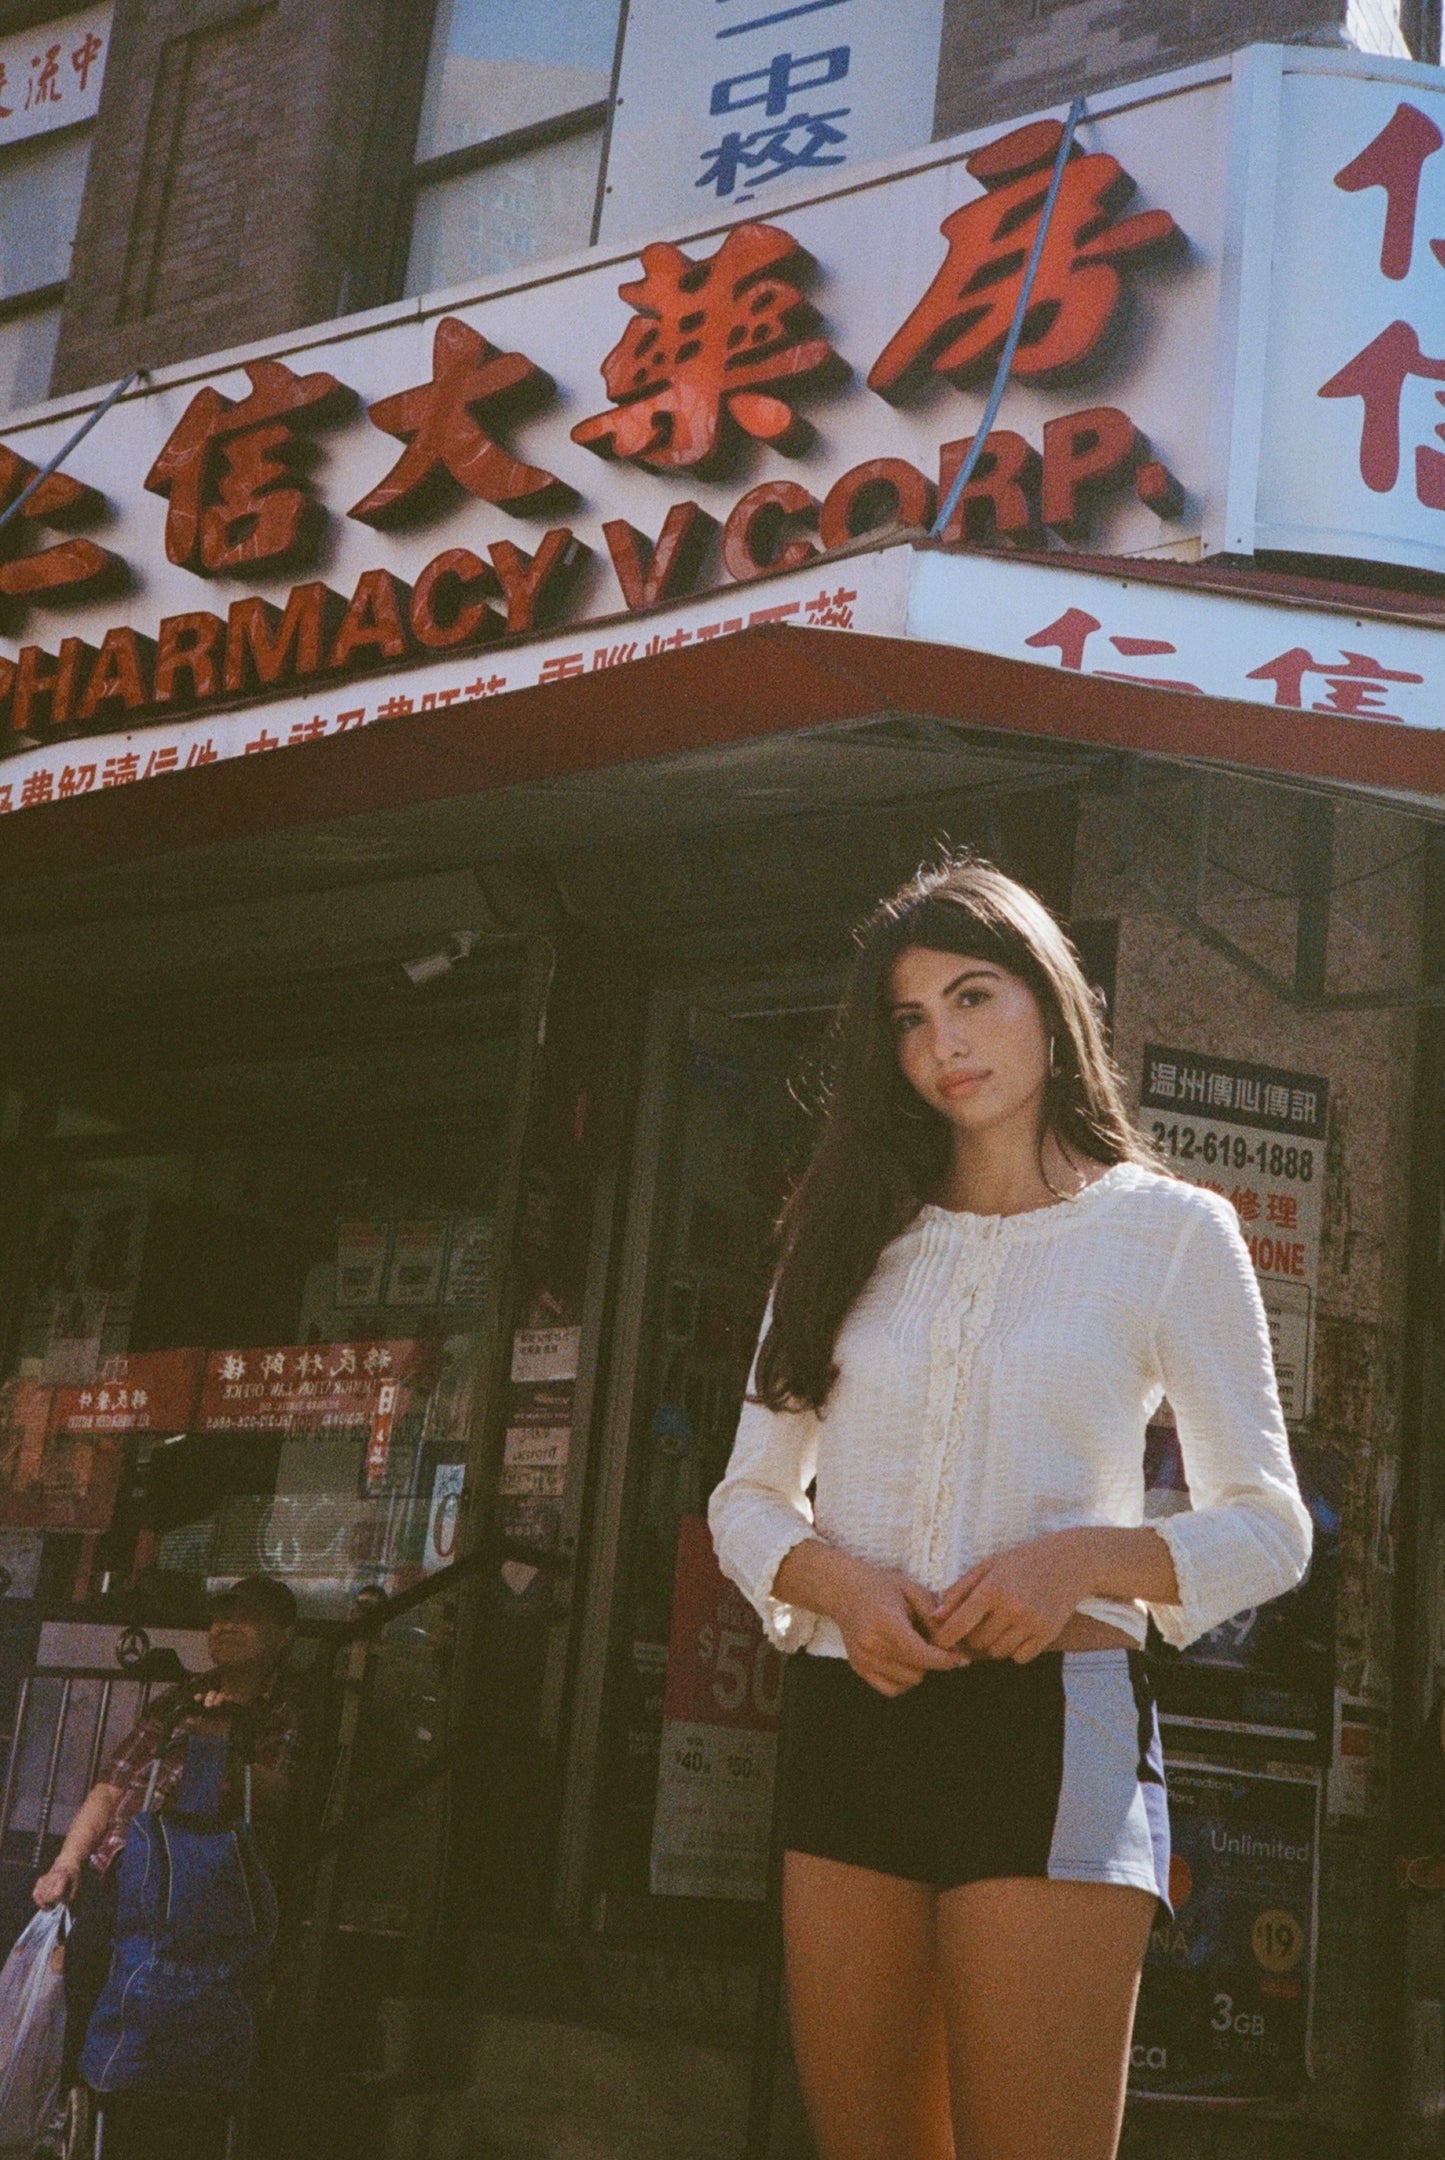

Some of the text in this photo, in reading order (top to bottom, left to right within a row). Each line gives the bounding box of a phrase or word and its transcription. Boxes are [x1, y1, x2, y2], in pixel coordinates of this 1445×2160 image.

[1152, 1121, 1314, 1182] 212-619-1888
[1246, 1234, 1306, 1276] HONE
[697, 1622, 786, 1716] $50
[1211, 1829, 1310, 1862] Unlimited
[1151, 1930, 1189, 1956] NA
[1131, 2045, 1167, 2070] ca
